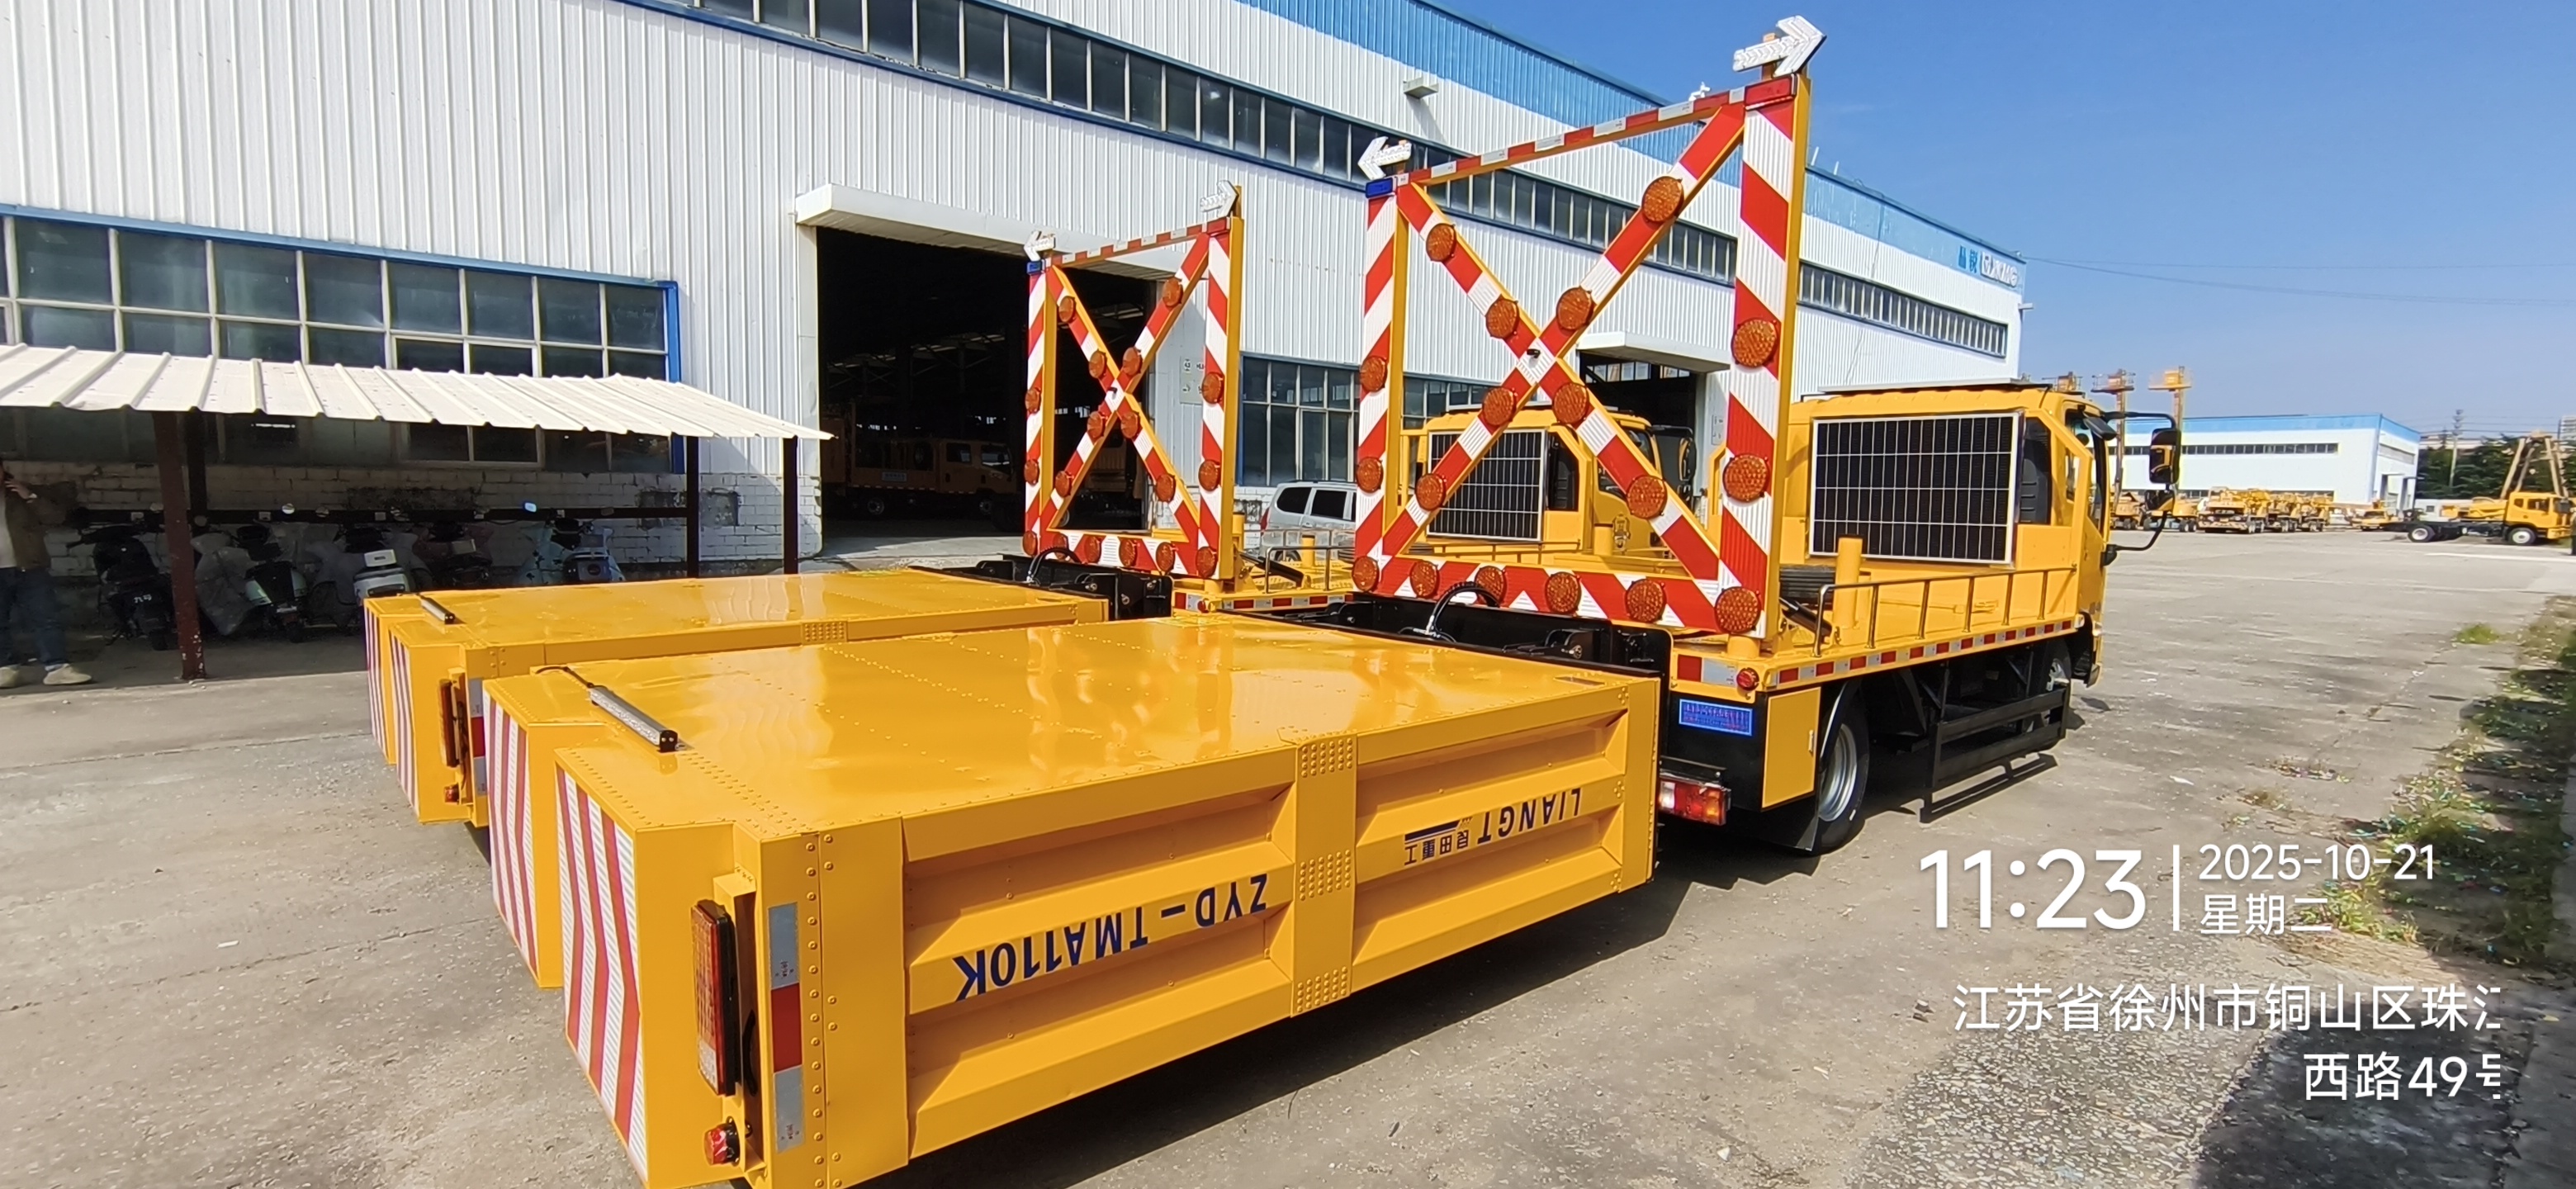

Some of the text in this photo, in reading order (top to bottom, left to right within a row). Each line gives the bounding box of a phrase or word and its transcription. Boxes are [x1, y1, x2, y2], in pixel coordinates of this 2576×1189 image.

[1404, 787, 1581, 866] LIANGT 良田重工
